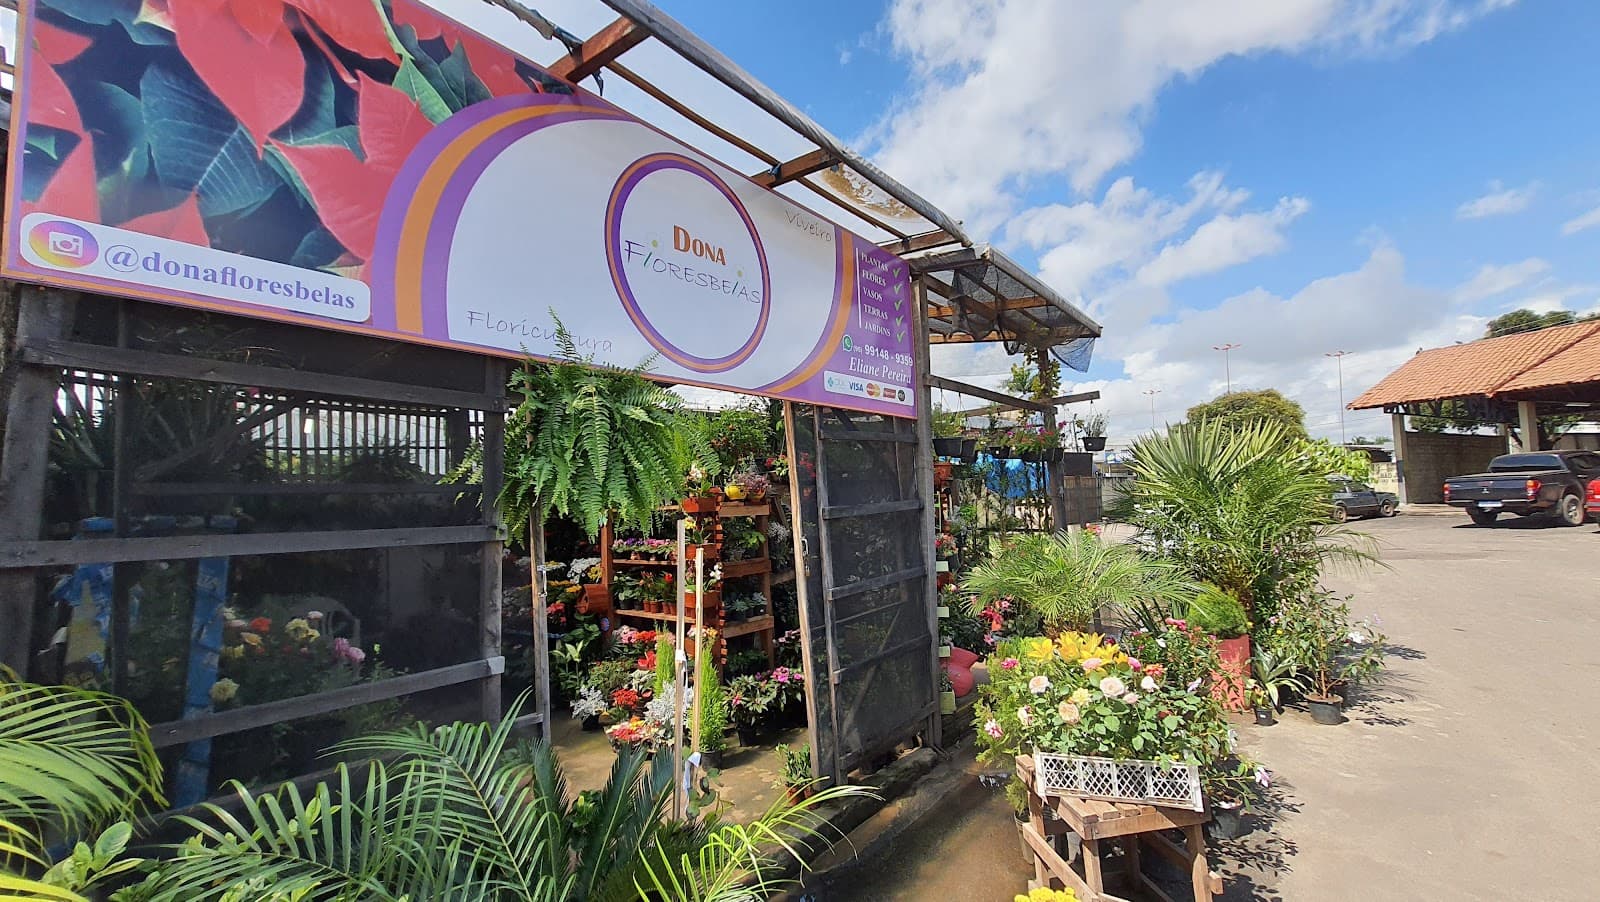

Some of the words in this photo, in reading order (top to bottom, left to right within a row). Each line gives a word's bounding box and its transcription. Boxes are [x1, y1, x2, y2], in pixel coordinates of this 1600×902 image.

[786, 209, 832, 242] Viveiro
[673, 224, 727, 266] DONA
[861, 252, 889, 272] PLANTAS
[104, 244, 355, 309] @donafloresbelas
[862, 269, 887, 287] FLORES
[863, 287, 883, 302] VASOS
[864, 304, 889, 320] TERRAS
[864, 344, 889, 361] 99148
[895, 353, 913, 367] 9359
[849, 356, 880, 377] Eliane
[882, 365, 912, 384] Pereira
[849, 381, 864, 392] VISA
